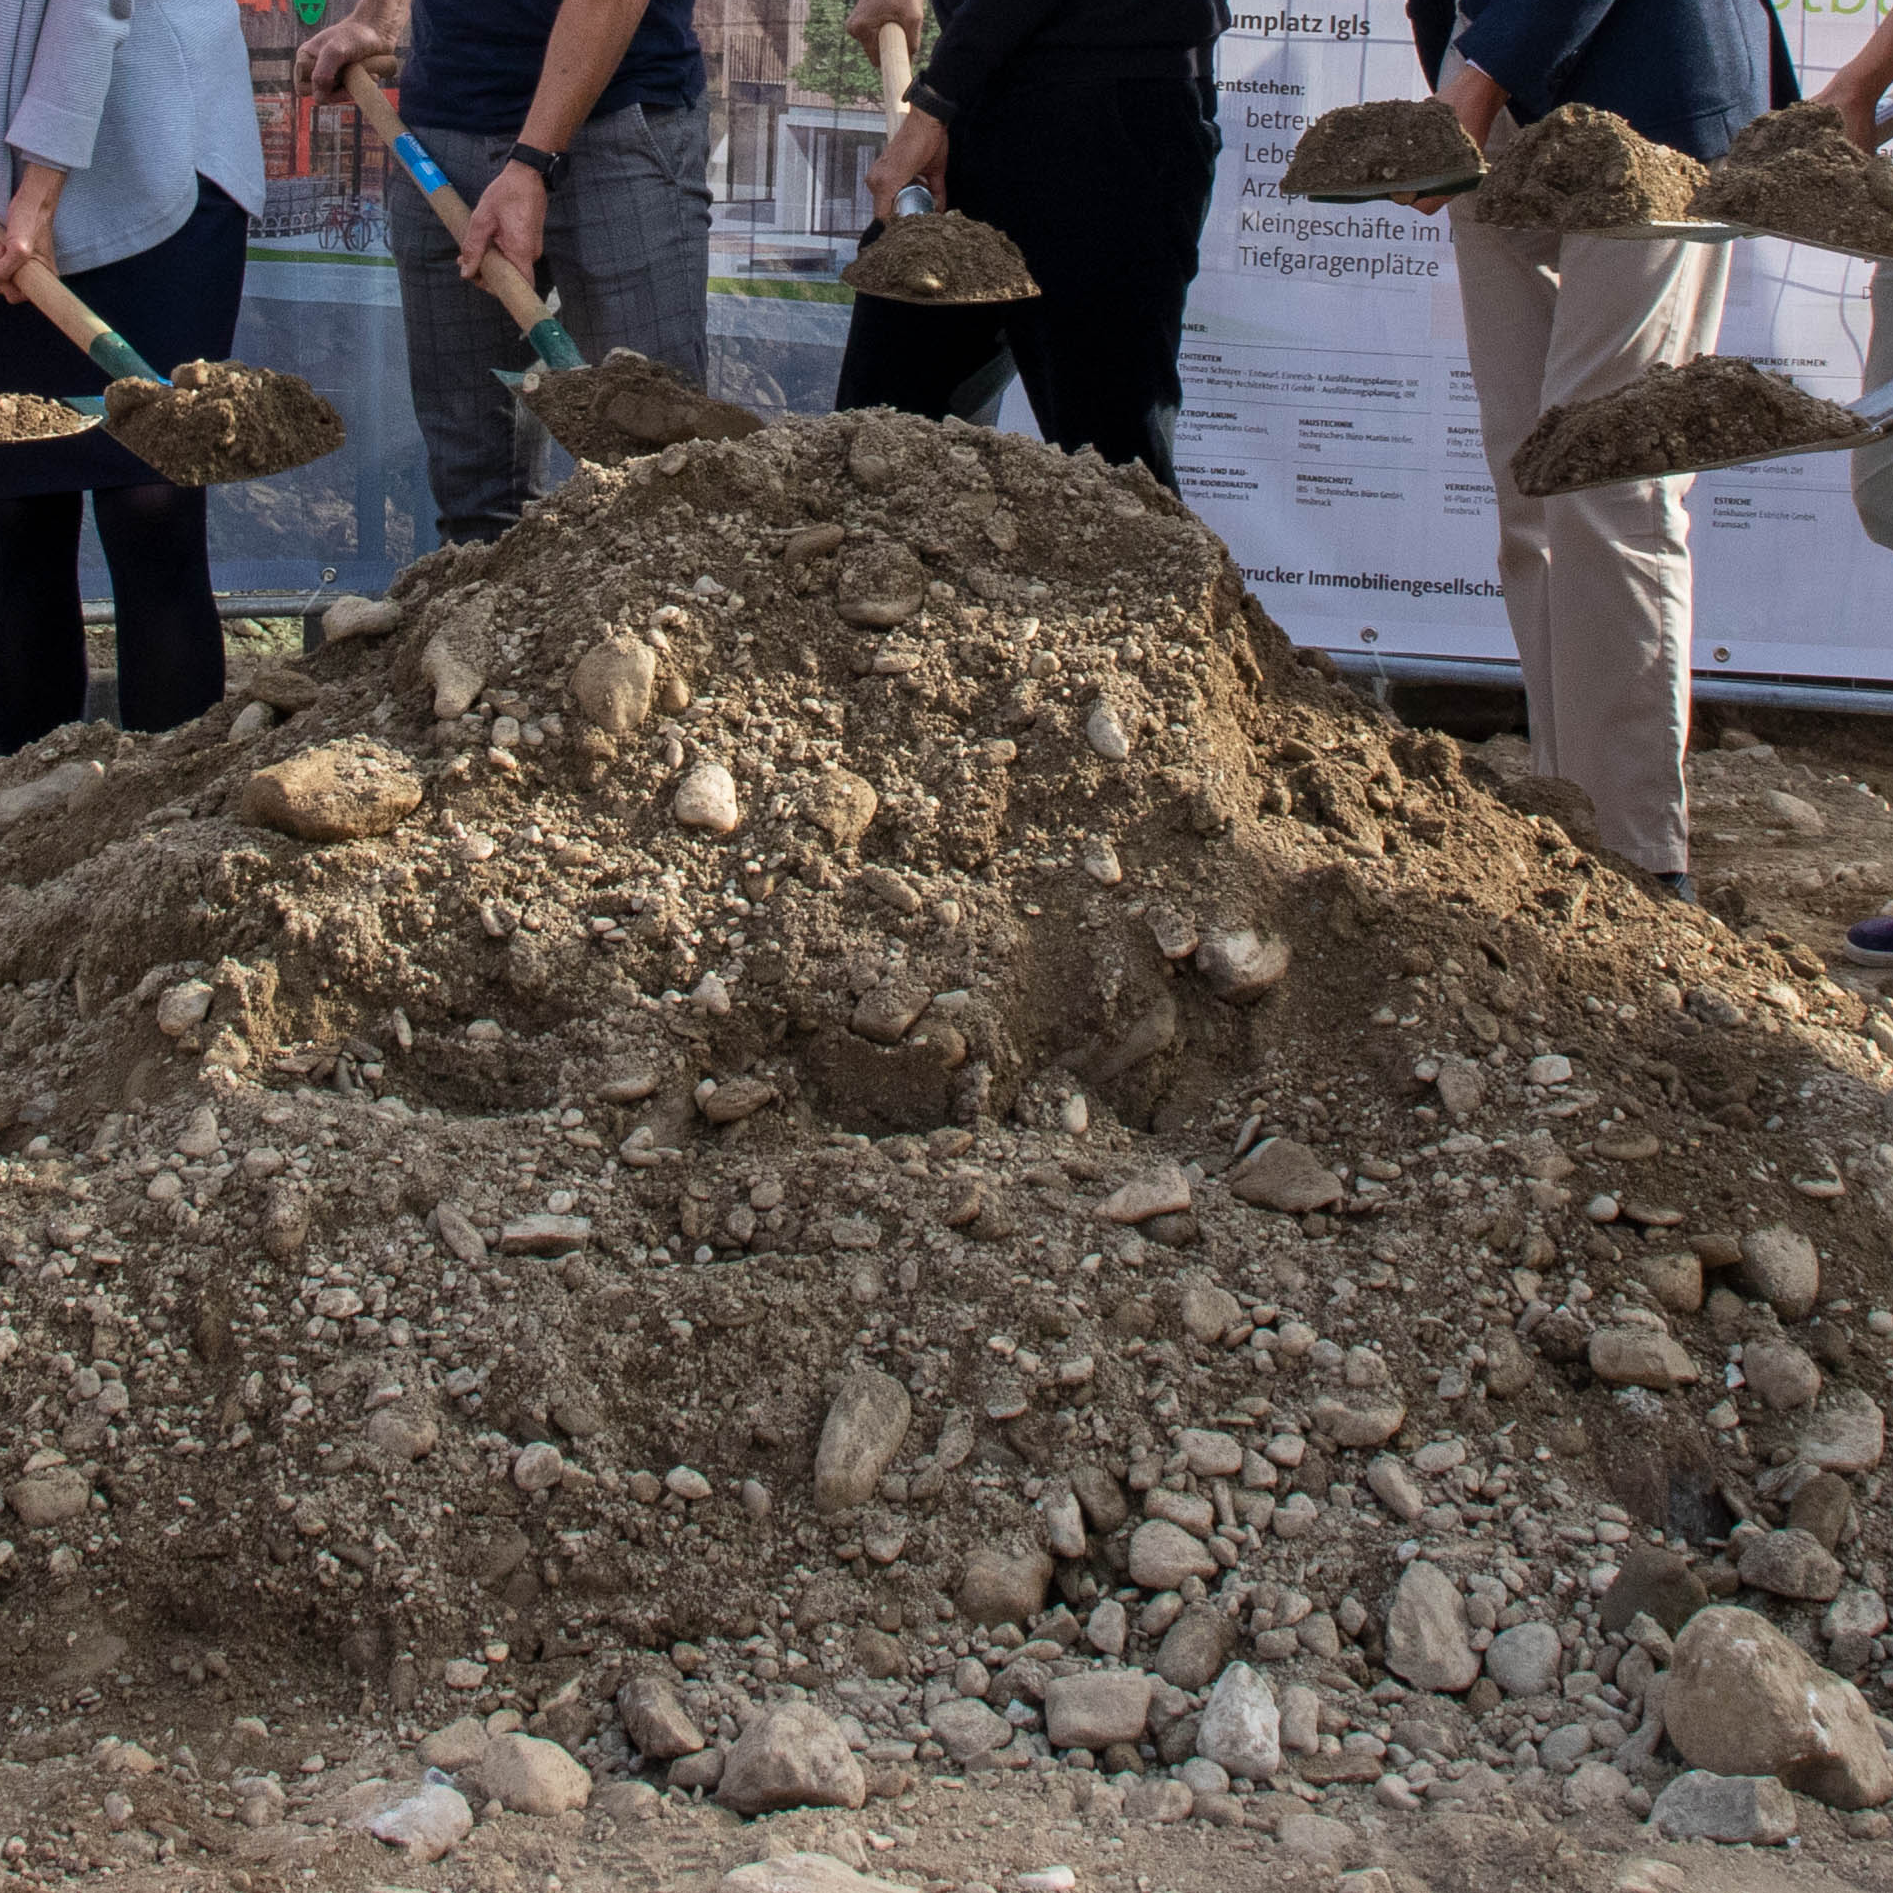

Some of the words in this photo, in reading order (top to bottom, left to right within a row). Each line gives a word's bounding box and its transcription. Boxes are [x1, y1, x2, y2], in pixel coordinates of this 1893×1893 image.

[1229, 10, 1323, 36] umplatz
[1330, 13, 1371, 41] Igls
[1215, 79, 1305, 96] entstehen:
[1241, 211, 1405, 241] Kleingeschäfte
[1412, 220, 1440, 242] im
[1239, 246, 1439, 279] Tiefgaragenplätze
[1182, 323, 1208, 333] ANER:
[1180, 352, 1222, 363] CHITEKTEN
[1180, 410, 1237, 419] KTROPLANUNG
[1444, 483, 1495, 493] VERKEHRSPL
[1308, 570, 1505, 598] Immobiliengesellscha
